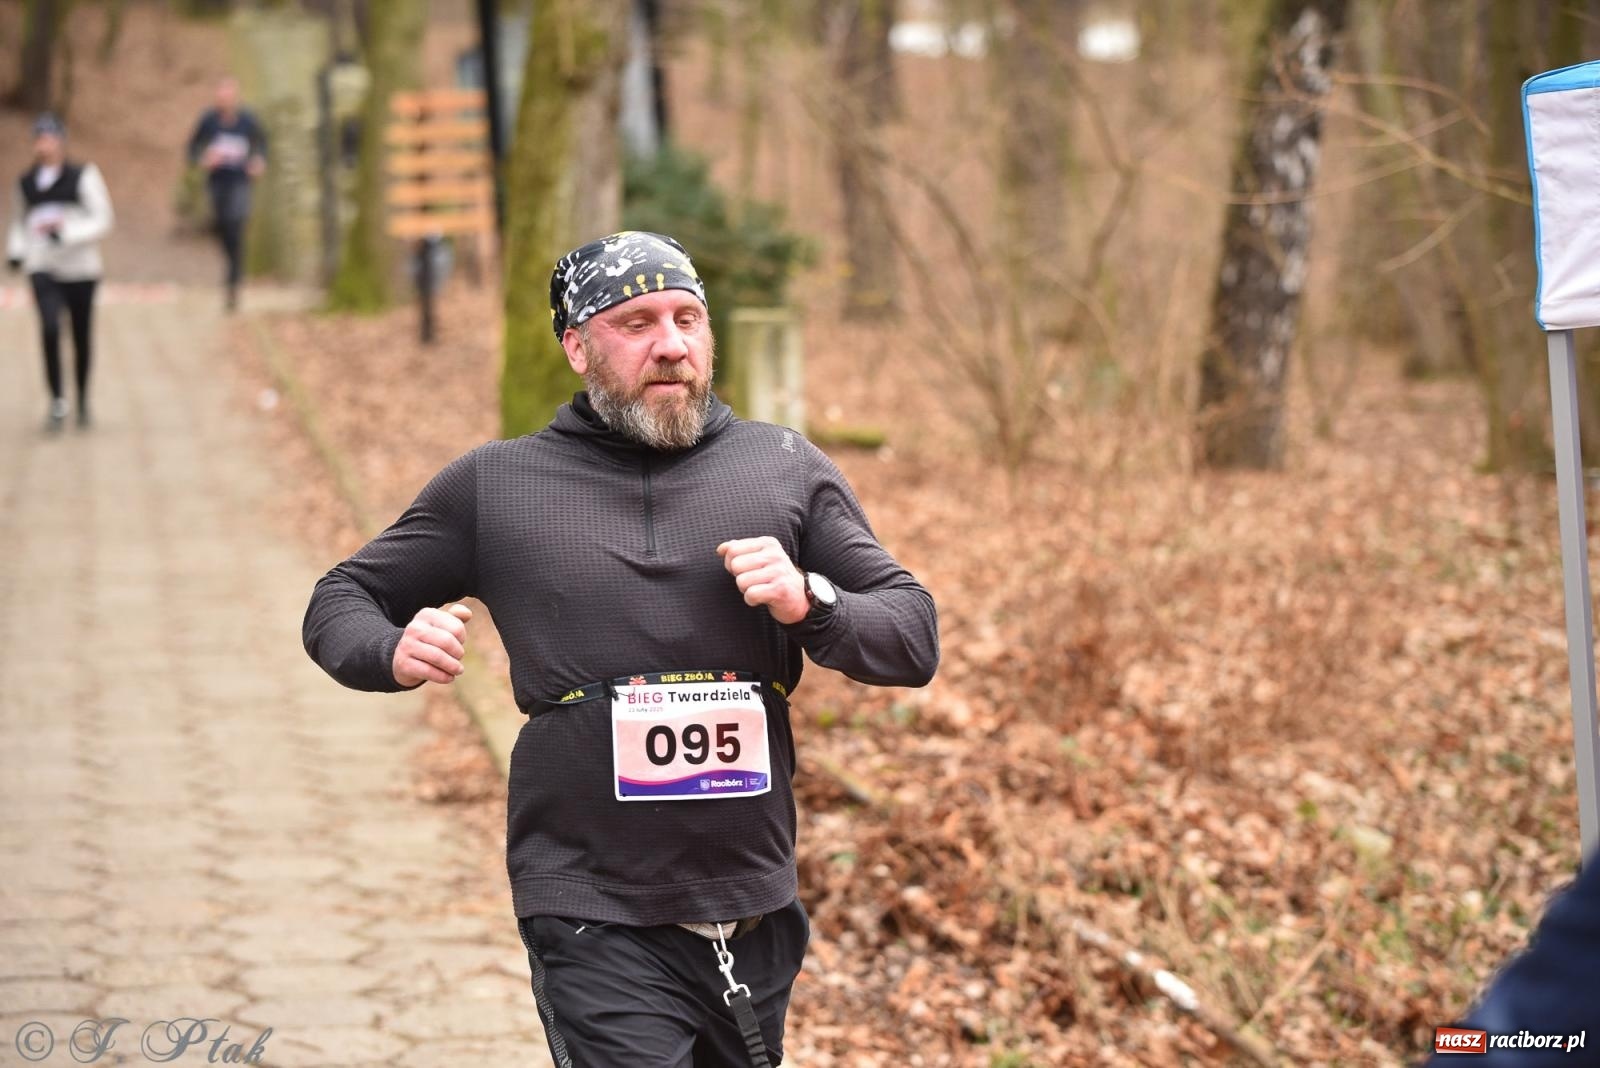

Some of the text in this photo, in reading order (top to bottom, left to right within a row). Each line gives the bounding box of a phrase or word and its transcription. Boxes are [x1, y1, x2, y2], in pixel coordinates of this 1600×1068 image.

[660, 674, 683, 683] BIEG
[628, 688, 750, 704] BIEG Twardziela
[645, 723, 741, 766] 095
[710, 778, 743, 788] Racibórz
